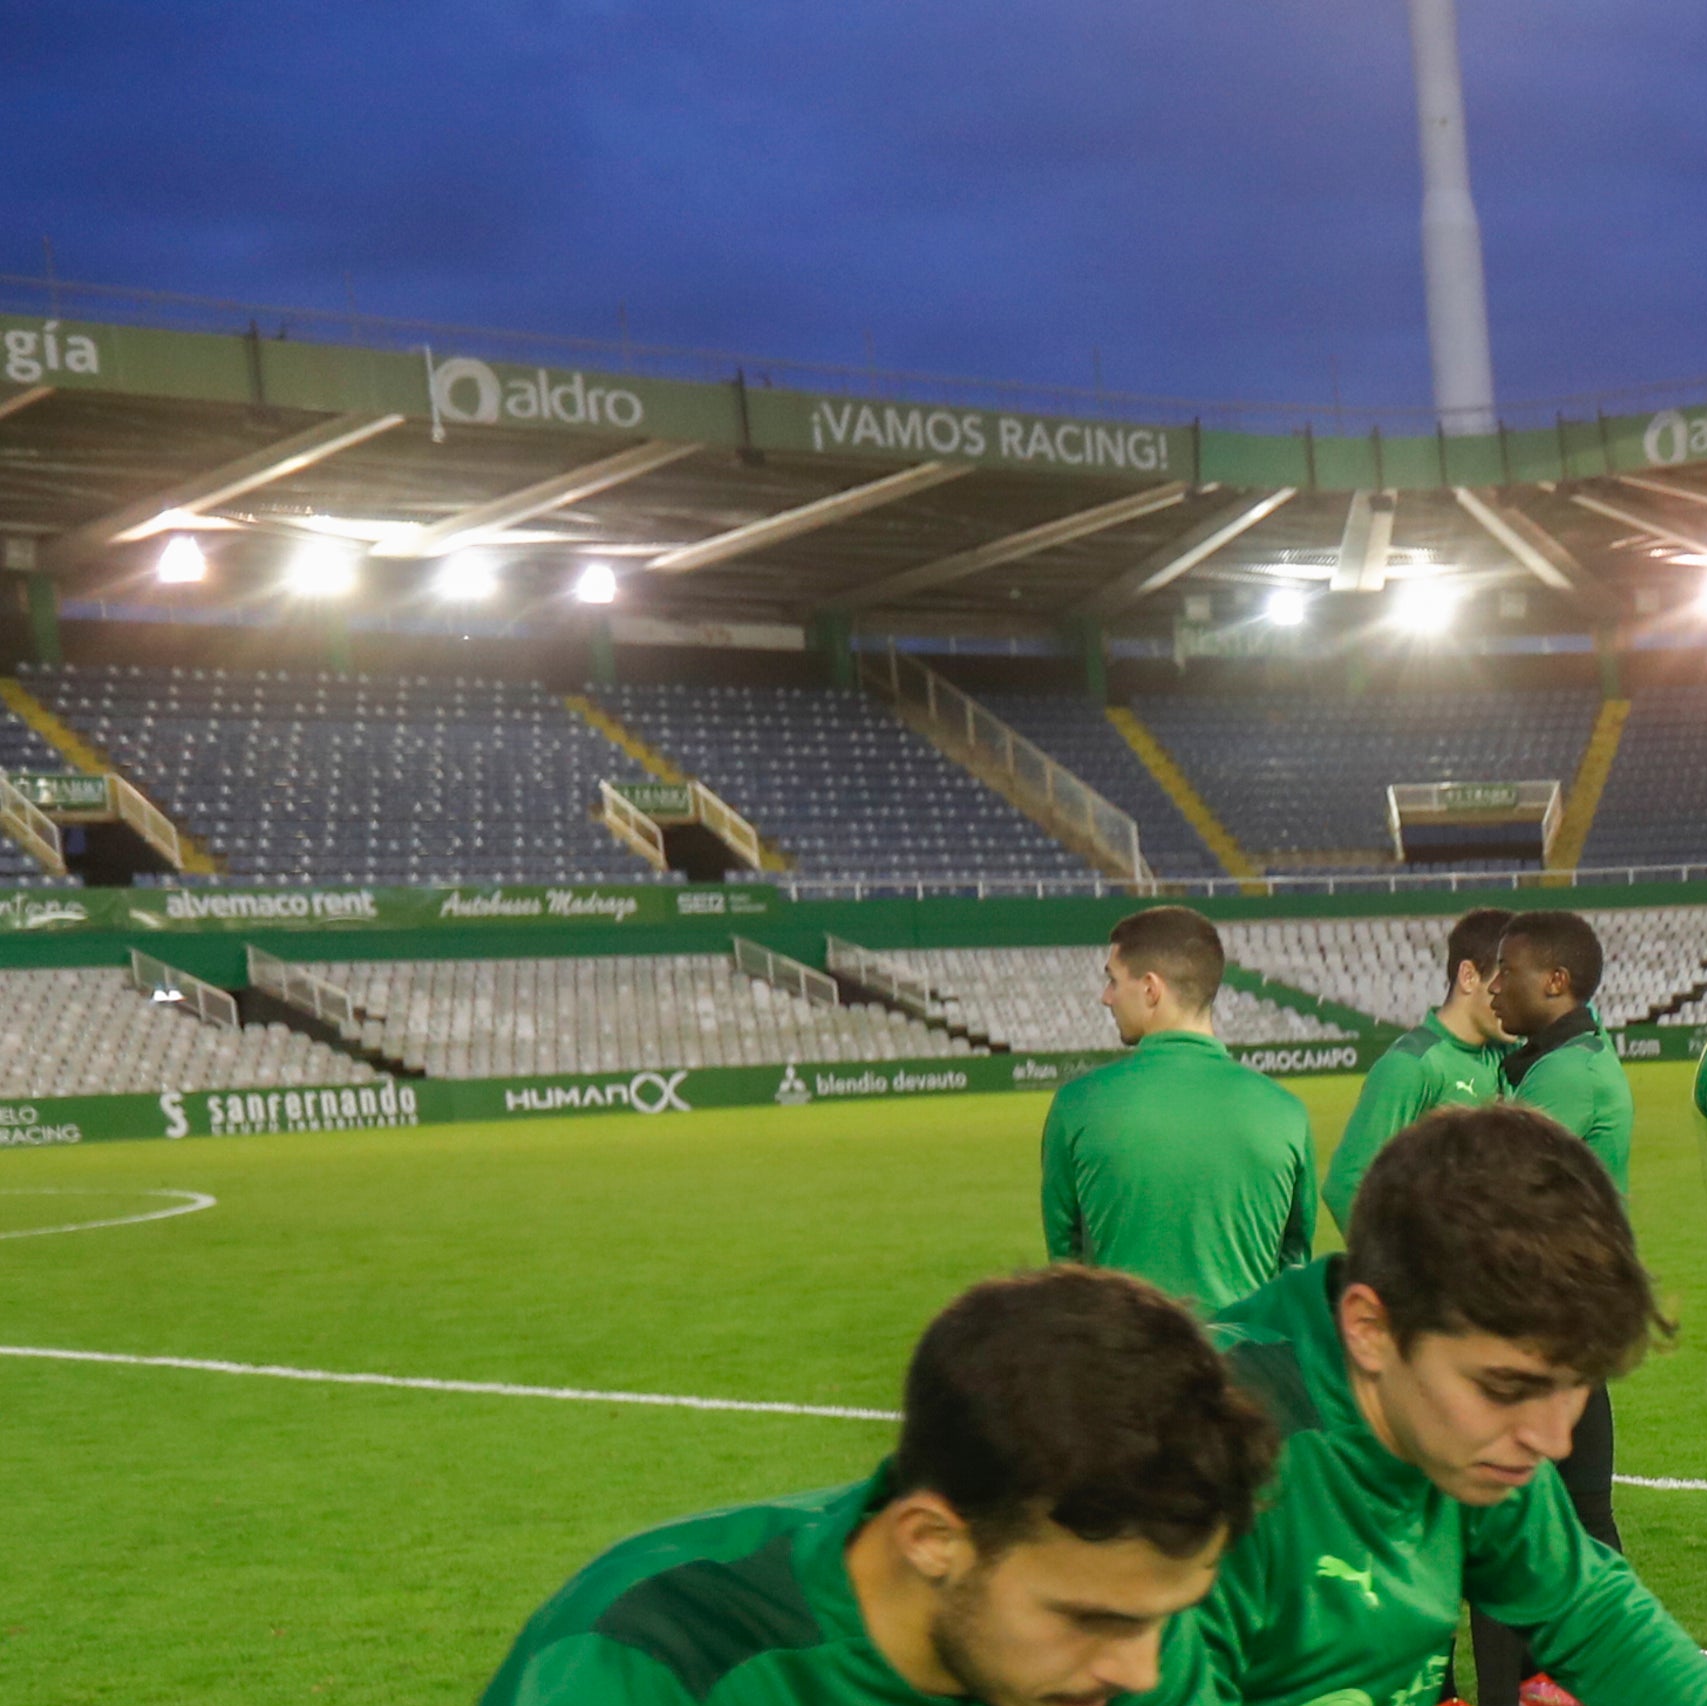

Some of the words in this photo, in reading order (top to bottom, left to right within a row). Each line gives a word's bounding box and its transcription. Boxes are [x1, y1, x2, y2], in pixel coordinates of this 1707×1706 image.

[503, 368, 642, 428] aldro
[811, 401, 986, 456] ¡VAMOS
[1000, 417, 1169, 471] RACING!
[312, 889, 378, 918] rent
[1238, 1046, 1358, 1072] AGROCAMPO
[207, 1074, 418, 1125] sanfernando
[815, 1069, 888, 1096] blendio
[892, 1068, 967, 1092] devauto
